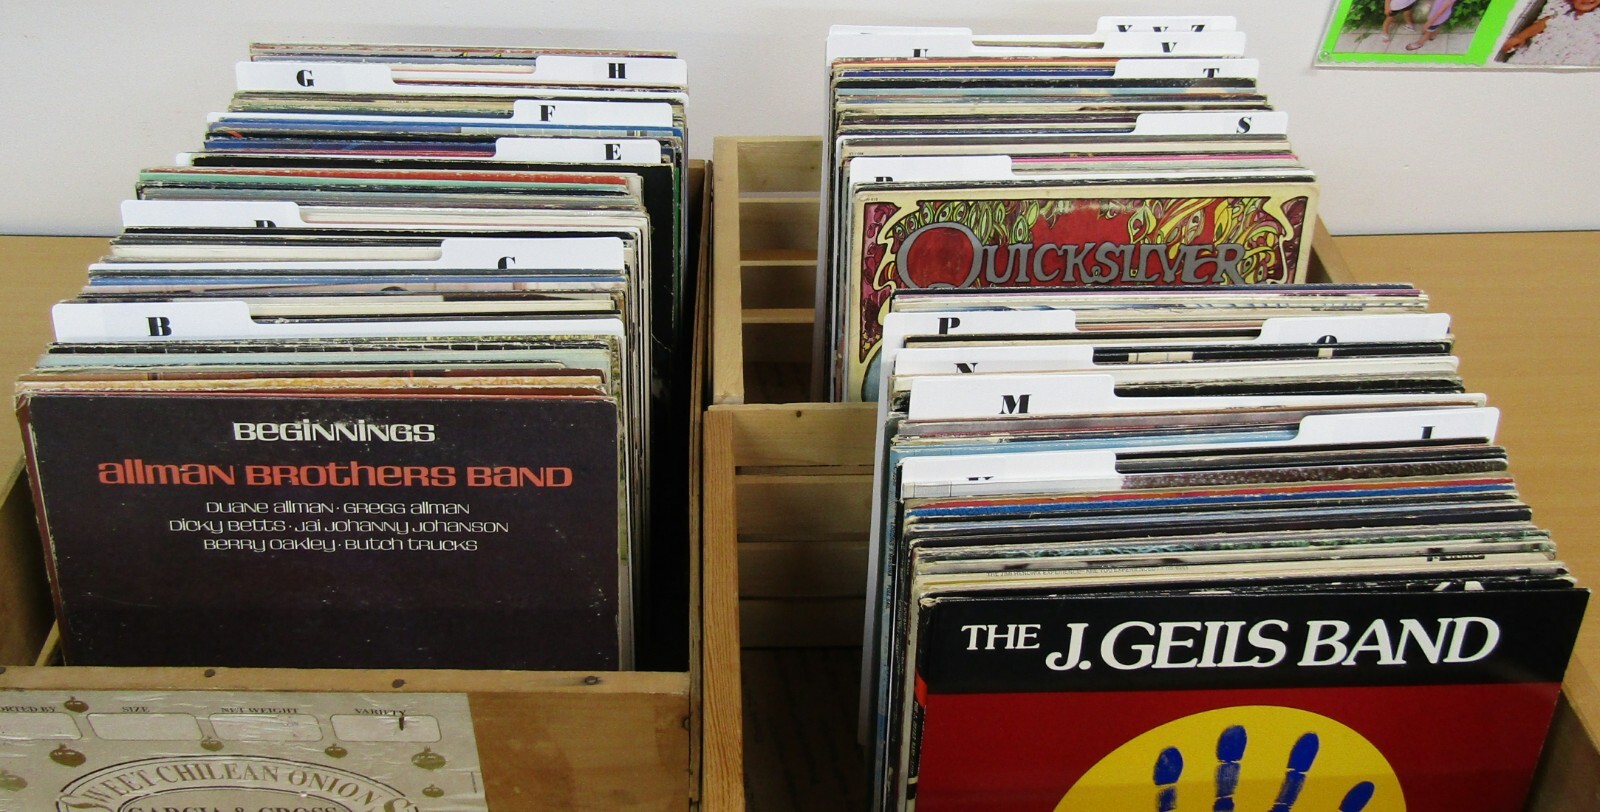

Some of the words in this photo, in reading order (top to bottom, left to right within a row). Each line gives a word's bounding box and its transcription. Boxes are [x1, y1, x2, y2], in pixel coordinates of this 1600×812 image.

[296, 69, 314, 87] G
[608, 62, 626, 79] H
[540, 105, 556, 122] F
[1236, 116, 1252, 134] S
[603, 143, 621, 160] E
[896, 221, 1257, 287] QUICKSILVER
[146, 316, 172, 336] B
[937, 317, 961, 335] P
[998, 394, 1032, 415] M
[960, 623, 1041, 651] THE
[1045, 622, 1092, 670] J.
[1100, 619, 1289, 669] GEILS
[1297, 616, 1500, 666] BAND
[355, 708, 406, 716] VARIETY
[156, 763, 279, 783] CHILEAN
